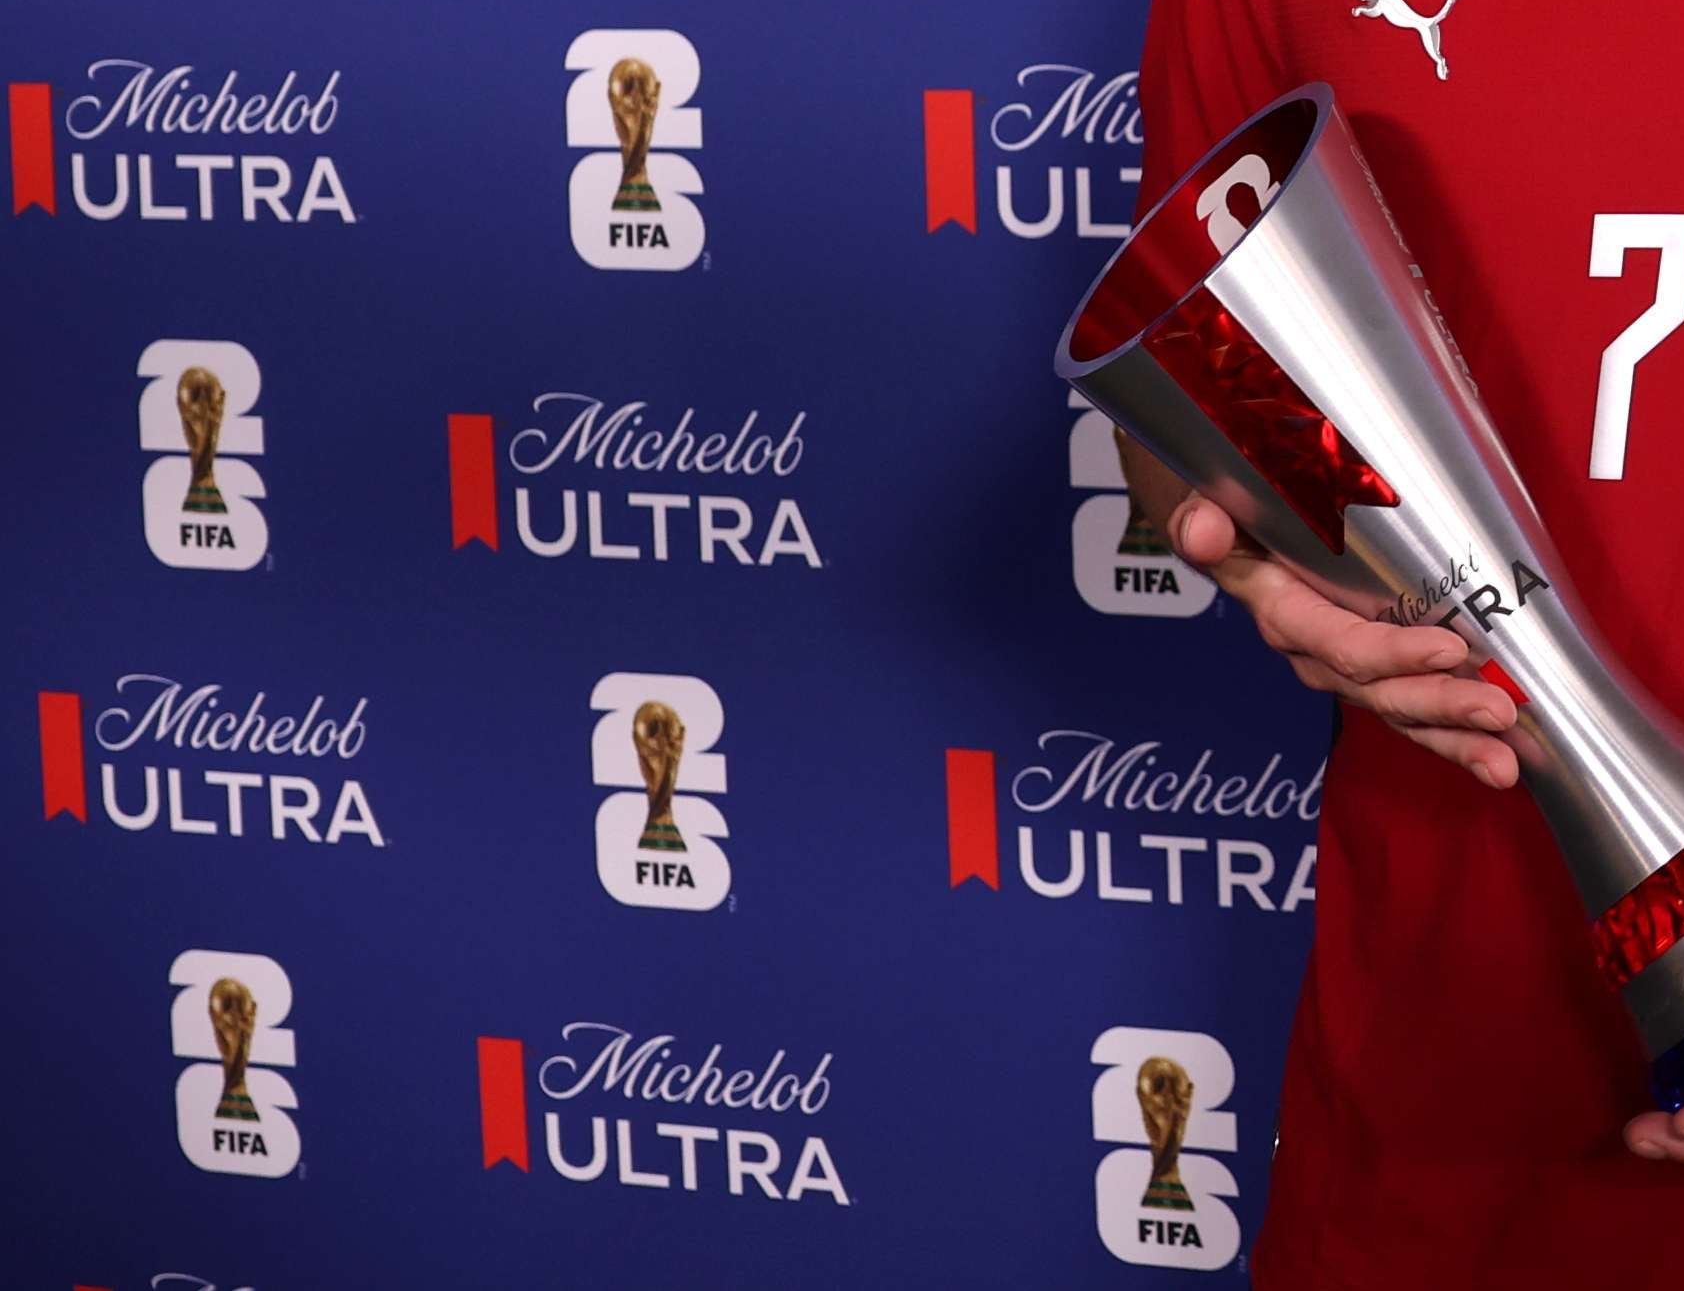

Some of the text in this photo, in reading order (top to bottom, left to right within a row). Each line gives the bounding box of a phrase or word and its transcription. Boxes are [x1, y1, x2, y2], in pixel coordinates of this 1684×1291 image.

[66, 60, 340, 139] Michelob
[72, 153, 356, 223] ULTRA
[609, 223, 670, 249] FIFA
[510, 393, 805, 475] Michelob
[180, 523, 236, 549] FIFA
[516, 488, 822, 568] ULTRA
[1114, 567, 1181, 595] FIFA
[1435, 559, 1550, 649] TRA
[96, 674, 367, 758] Michelob
[102, 764, 385, 847] ULTRA
[635, 861, 696, 889] FIFA
[539, 1022, 832, 1114] Michelob
[213, 1128, 269, 1157] FIFA
[545, 1112, 850, 1205] ULTRA
[1138, 1218, 1204, 1249] FIFA
